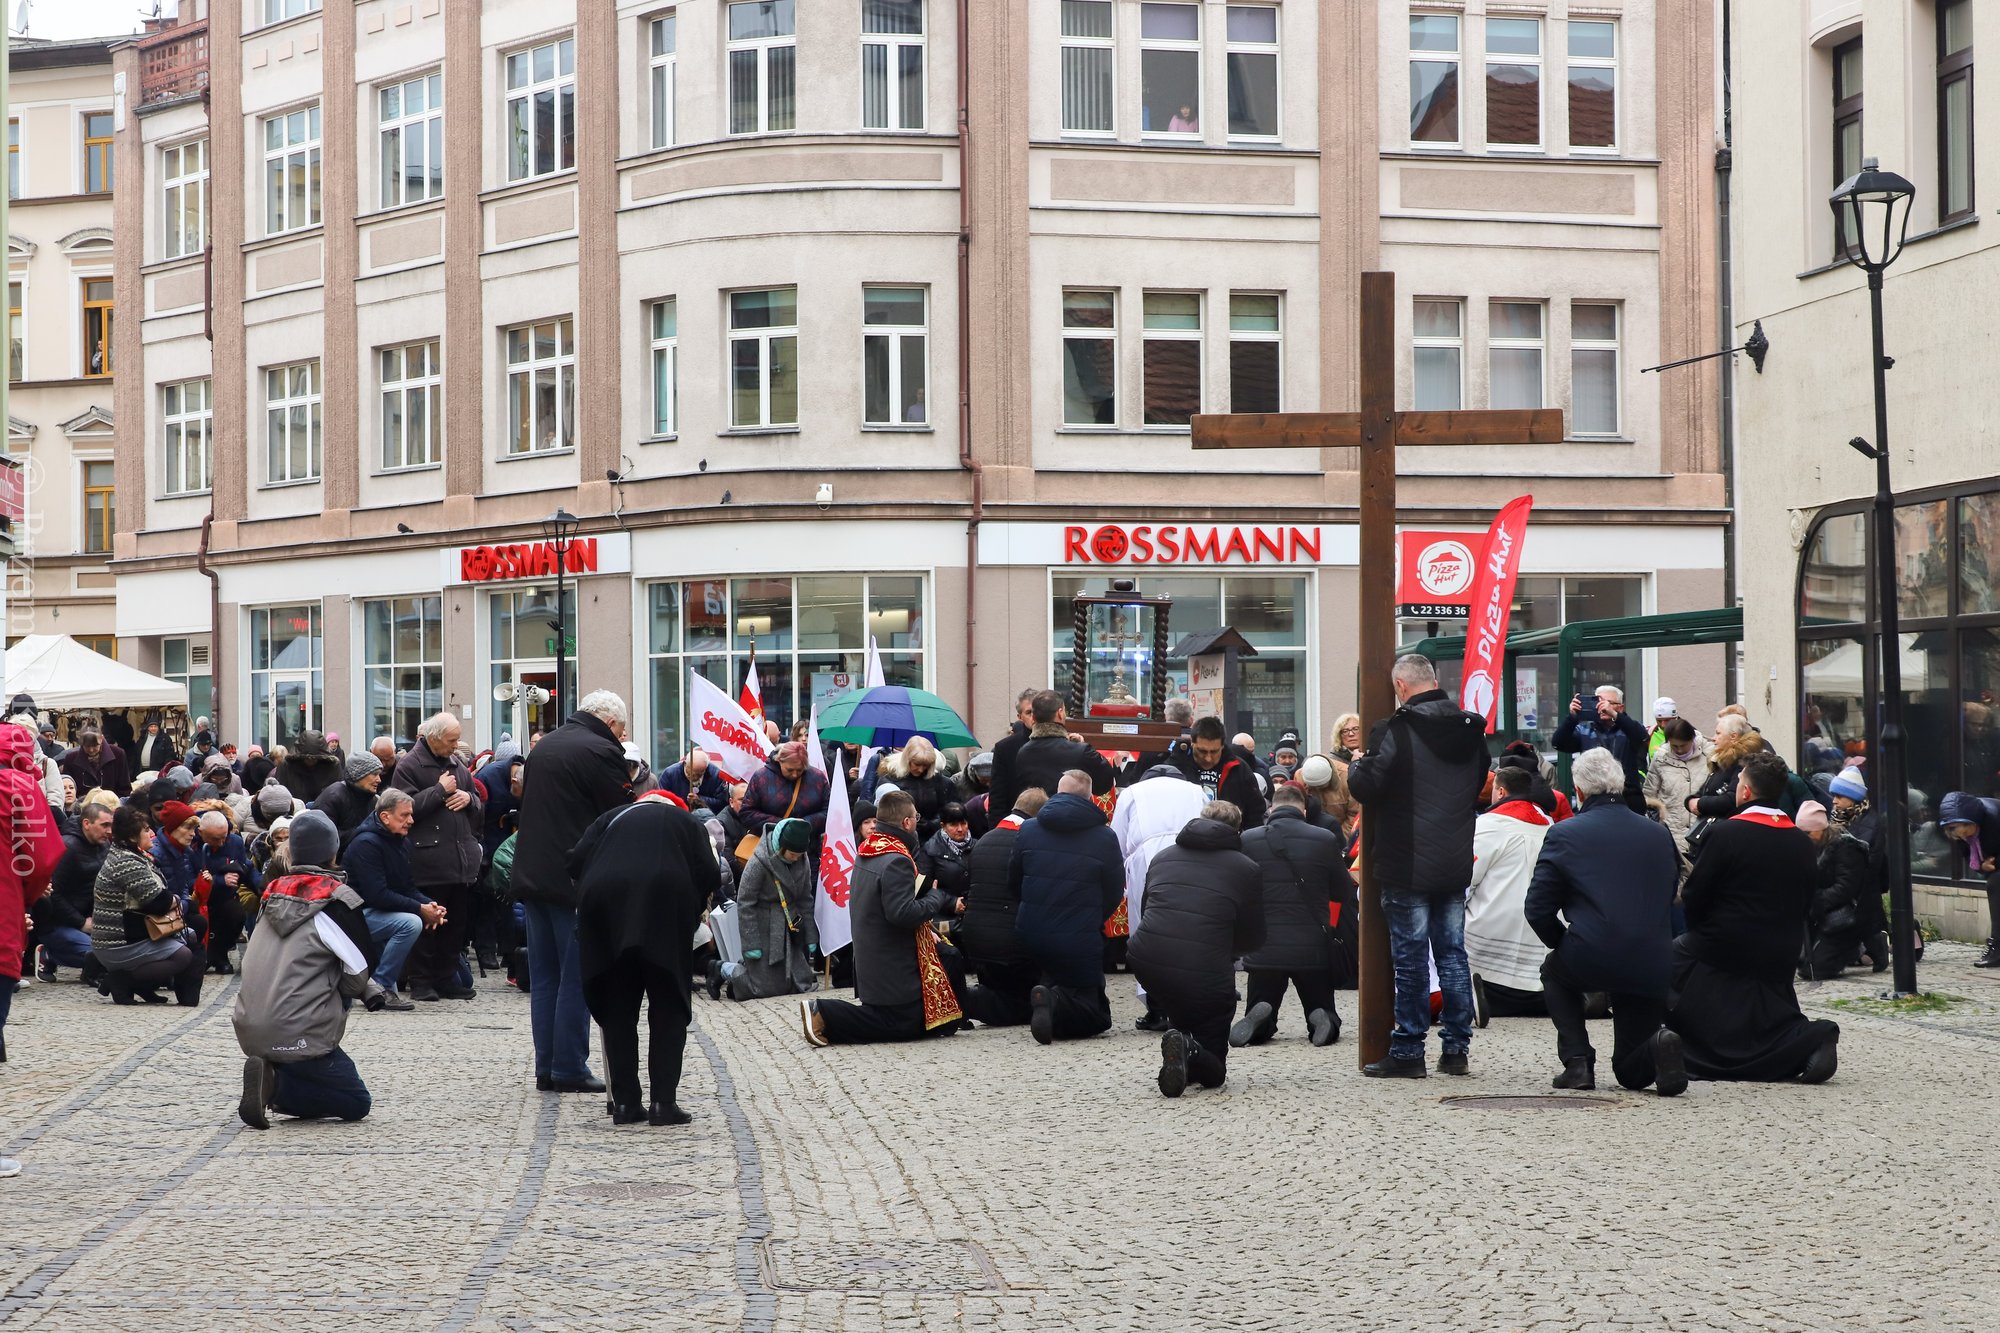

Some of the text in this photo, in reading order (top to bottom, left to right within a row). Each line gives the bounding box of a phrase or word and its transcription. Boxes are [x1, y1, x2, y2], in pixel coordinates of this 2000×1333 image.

[1064, 525, 1321, 563] ROSSMANN
[461, 538, 597, 581] ROSSMANN
[1428, 562, 1461, 578] Pizza
[1434, 573, 1459, 586] Hut
[1477, 520, 1513, 666] Pizza Hut
[1420, 605, 1467, 615] 22 536 36
